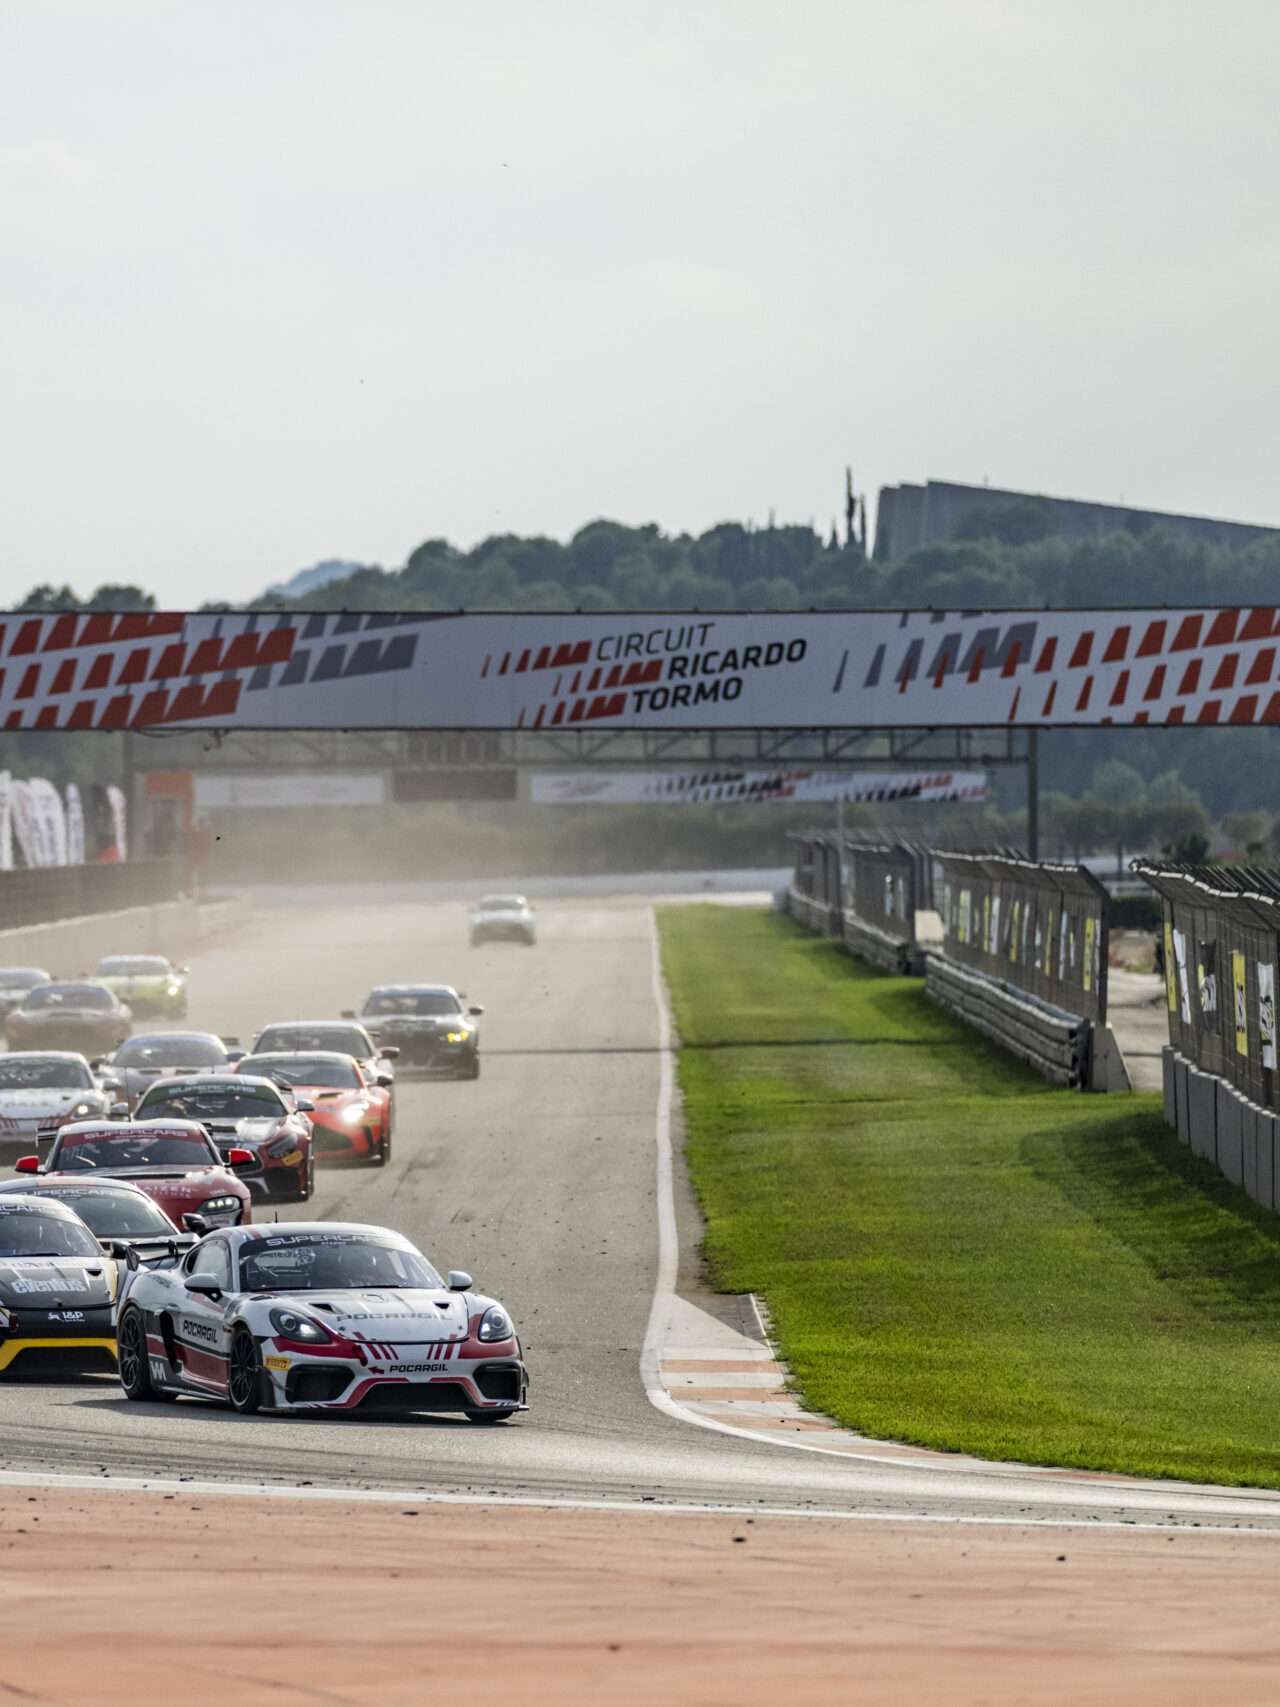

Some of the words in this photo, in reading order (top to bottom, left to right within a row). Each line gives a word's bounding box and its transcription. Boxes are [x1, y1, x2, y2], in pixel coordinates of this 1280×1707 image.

[597, 623, 715, 661] CIRCUIT
[668, 638, 807, 680] RICARDO
[633, 677, 743, 713] TORMO
[84, 1128, 188, 1140] SUPERCARS
[265, 1234, 390, 1247] SUPERCAR
[11, 1277, 87, 1294] eventos
[336, 1312, 453, 1322] POCARGIL
[182, 1319, 218, 1343] POCARGIL
[389, 1363, 449, 1373] POCARGIL
